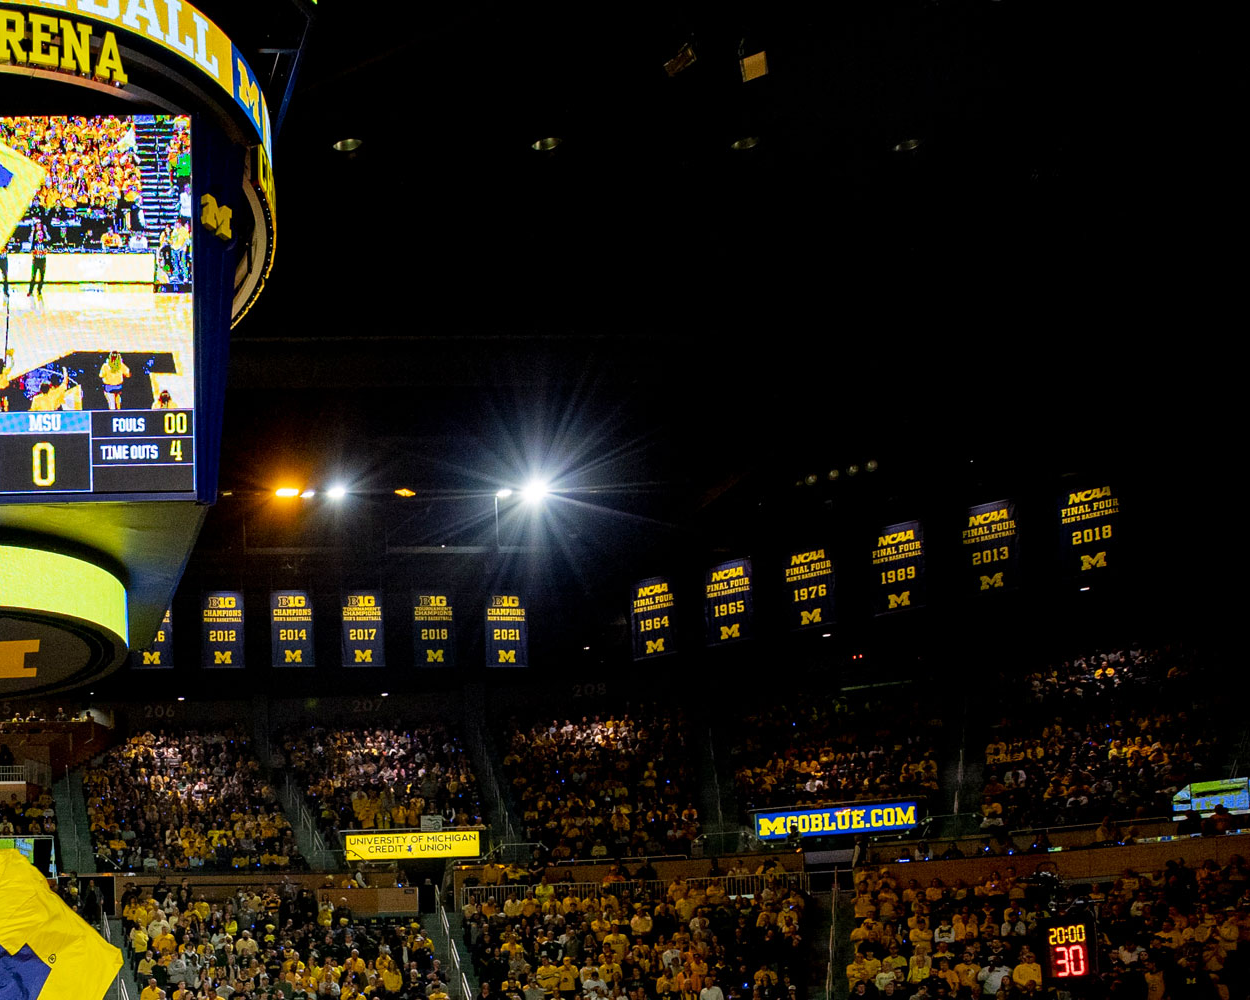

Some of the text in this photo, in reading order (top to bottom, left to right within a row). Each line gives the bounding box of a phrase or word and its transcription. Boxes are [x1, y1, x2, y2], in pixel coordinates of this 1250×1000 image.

[238, 57, 261, 129] M
[201, 192, 232, 240] M
[29, 414, 61, 432] MSU
[112, 412, 187, 434] FOULS 00
[100, 440, 182, 461] TIME OUTS 4
[32, 442, 55, 487] 0
[1068, 486, 1111, 505] NCAA
[1061, 498, 1119, 518] FINAL FOUR
[968, 509, 1008, 527] NCAA
[962, 520, 1016, 538] FINAL FOUR
[1072, 525, 1112, 545] 2018
[878, 529, 915, 547] NCAA
[791, 549, 825, 566] NCAA
[872, 541, 921, 559] FINAL FOUR
[972, 546, 1009, 565] 2013
[785, 560, 832, 577] FINAL FOUR
[1081, 552, 1106, 571] M
[712, 566, 743, 582] NCAA
[881, 566, 916, 584] 1989
[980, 572, 1004, 591] M
[638, 583, 668, 598] NCAA
[706, 577, 750, 593] FINAL FOUR
[794, 584, 827, 602] 1976
[634, 593, 674, 608] FINAL FOUR
[888, 591, 910, 609] M
[203, 609, 242, 617] CHAMPIONS
[487, 608, 525, 616] CHAMPIONS
[714, 601, 745, 617] 1965
[801, 608, 822, 625] M
[640, 616, 669, 632] 1964
[720, 624, 740, 640] M
[209, 630, 236, 642] 2012
[279, 629, 306, 640] 2014
[349, 629, 377, 640] 2017
[421, 629, 448, 640] 2018
[493, 629, 520, 640] 2021
[646, 638, 664, 653] M
[143, 652, 160, 665] M
[214, 651, 232, 664] M
[285, 650, 302, 663] M
[355, 649, 372, 663] M
[427, 649, 444, 662] M
[498, 650, 516, 663] M
[350, 836, 408, 845] UNIVERSITY
[427, 834, 477, 842] MICHIGAN
[368, 845, 403, 853] CREDIT
[1049, 925, 1085, 945] 20:00
[1055, 945, 1084, 977] 30
